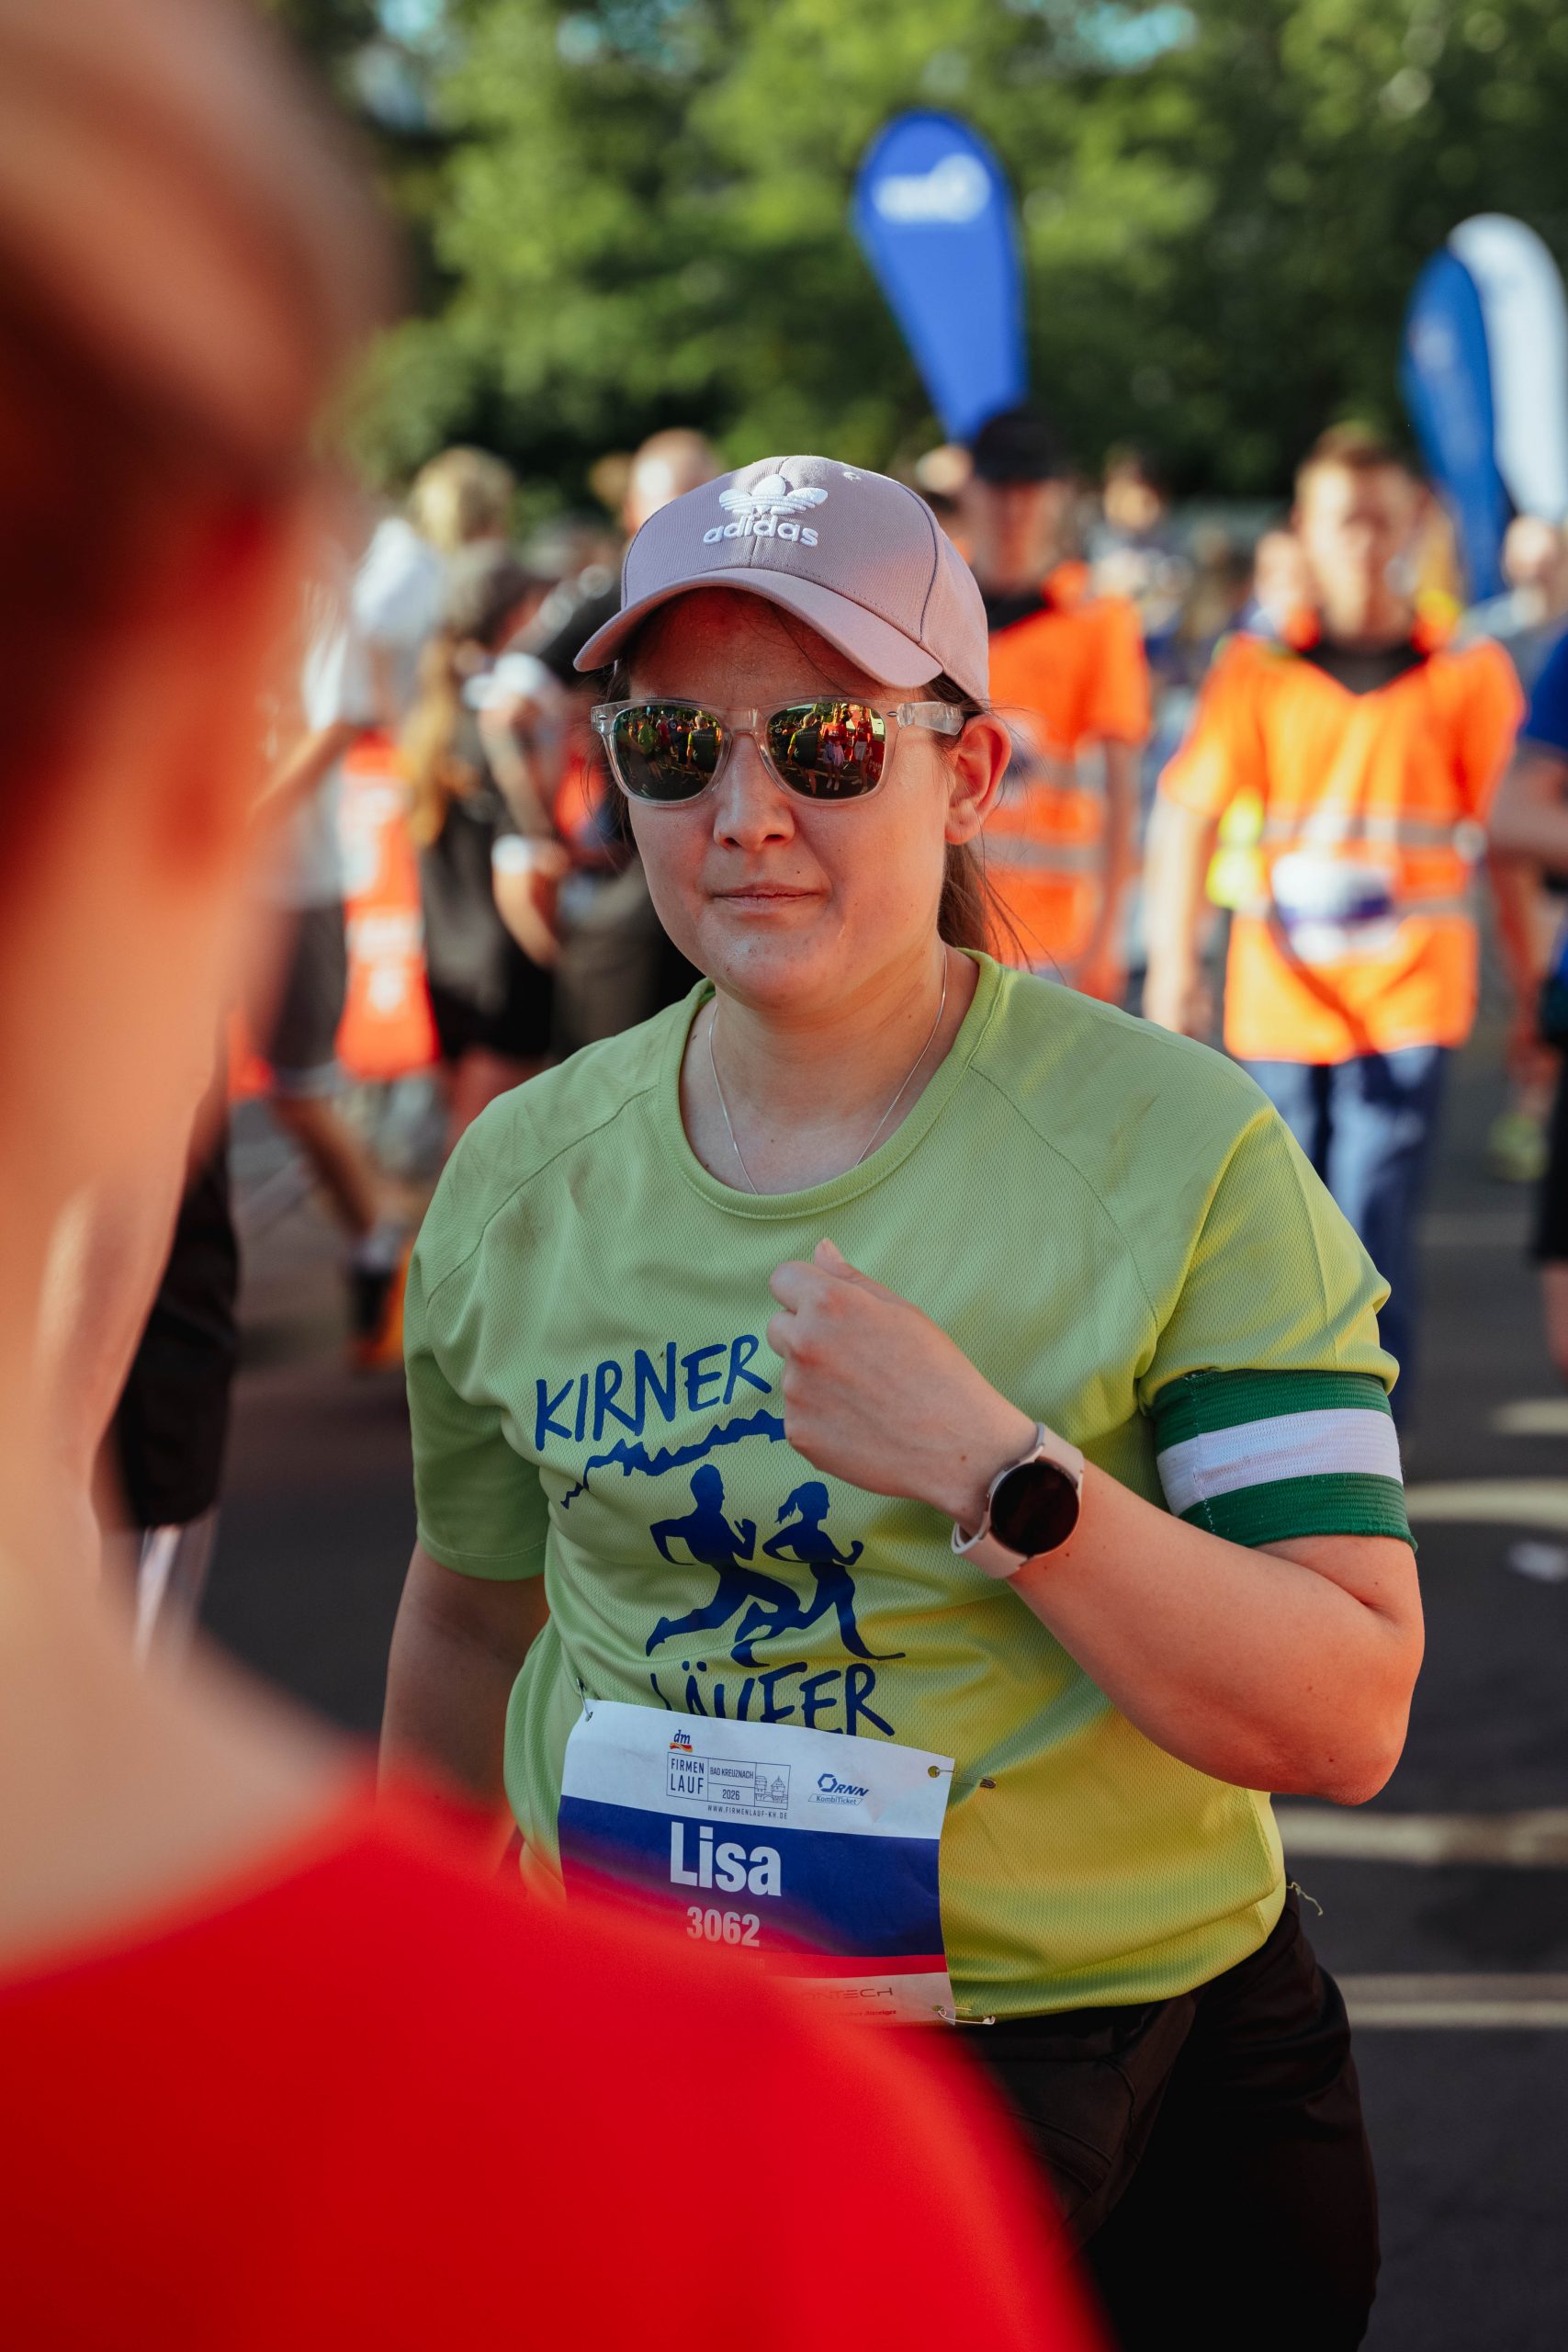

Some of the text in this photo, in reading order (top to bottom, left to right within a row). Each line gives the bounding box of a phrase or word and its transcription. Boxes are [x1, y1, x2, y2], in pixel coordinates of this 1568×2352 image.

[703, 514, 818, 547] adidas
[535, 1334, 773, 1452] KIRNER
[673, 1729, 691, 1745] dm
[671, 1758, 705, 1774] FIRMEN
[709, 1766, 754, 1780] BAD KREUZNACH
[671, 1773, 705, 1794] LAUF
[722, 1789, 740, 1801] 2026
[816, 1795, 857, 1805] KombiTicket
[707, 1804, 788, 1820] WWW.FIRMENLAUF-KH.DE
[671, 1821, 782, 1897] Lisa
[686, 1905, 761, 1948] 3062
